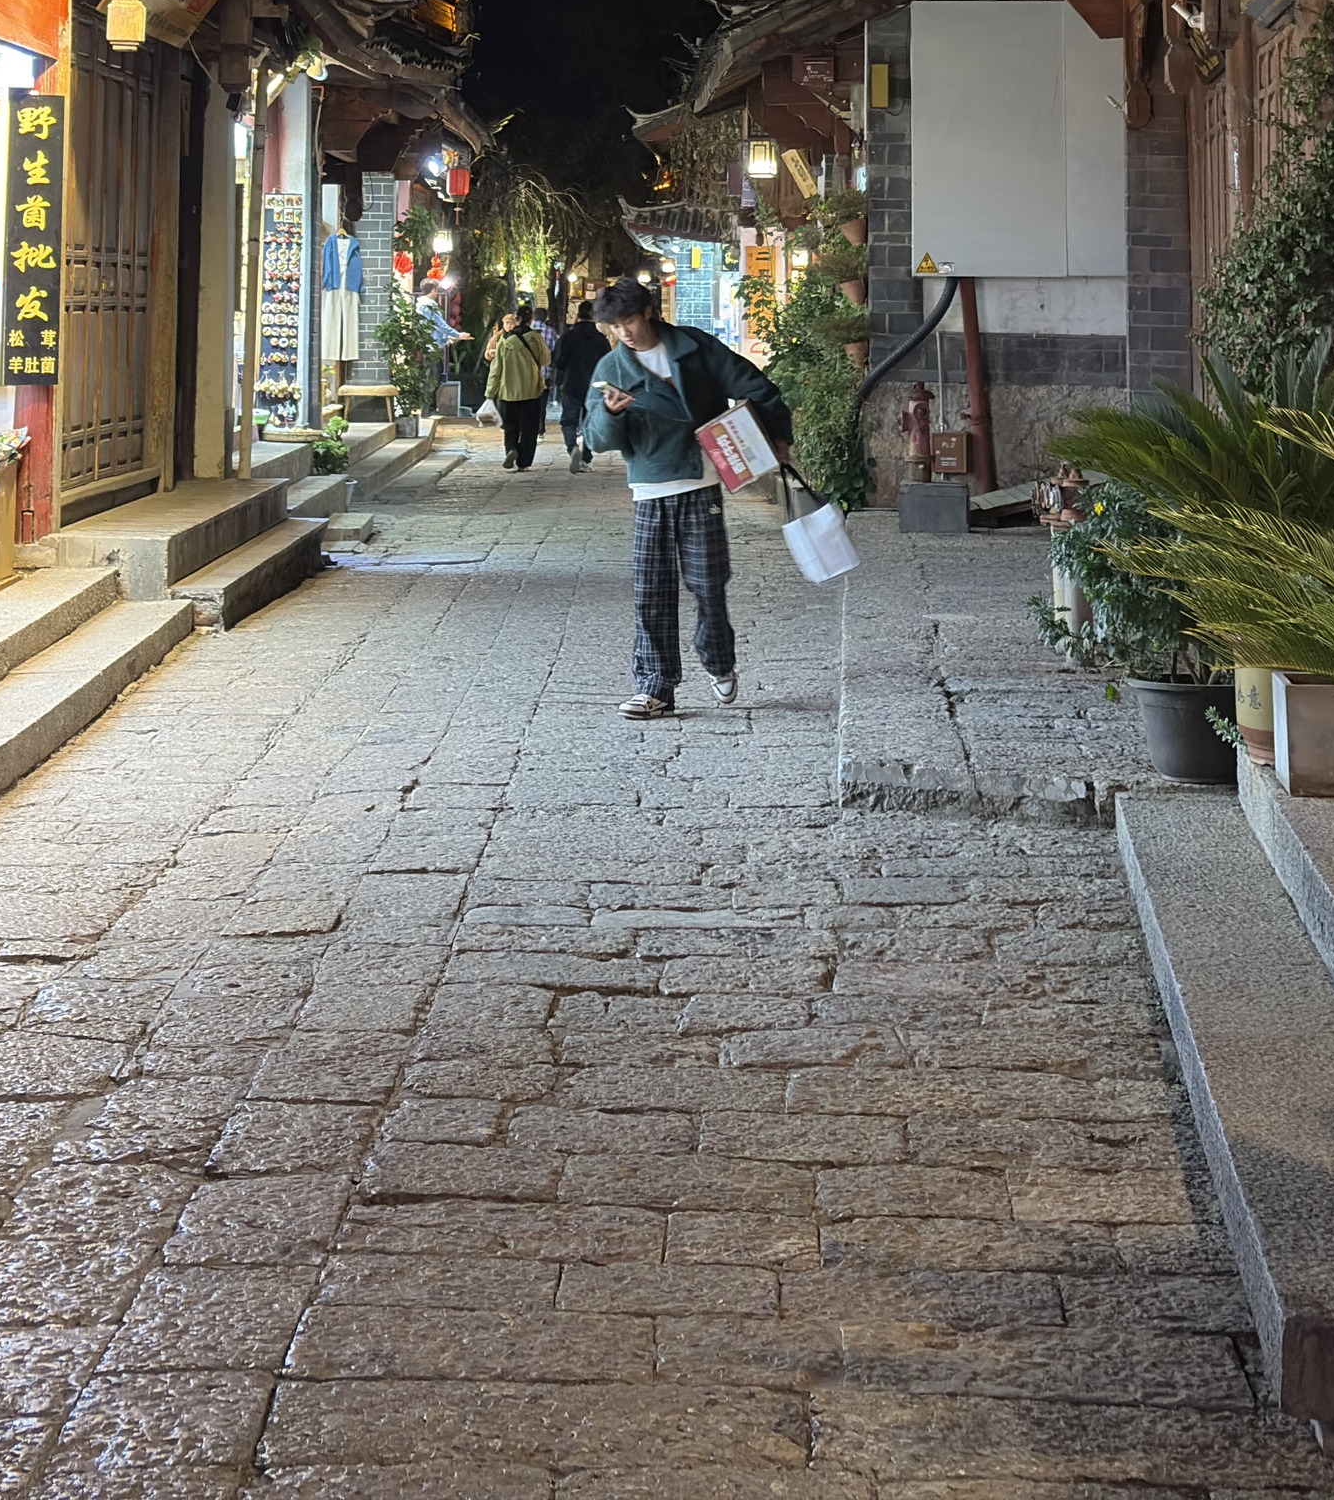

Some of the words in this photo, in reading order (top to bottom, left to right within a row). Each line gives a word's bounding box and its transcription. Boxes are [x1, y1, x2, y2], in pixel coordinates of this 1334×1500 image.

[10, 105, 57, 322] 野生菌批发
[8, 356, 56, 374] 羊肚菌
